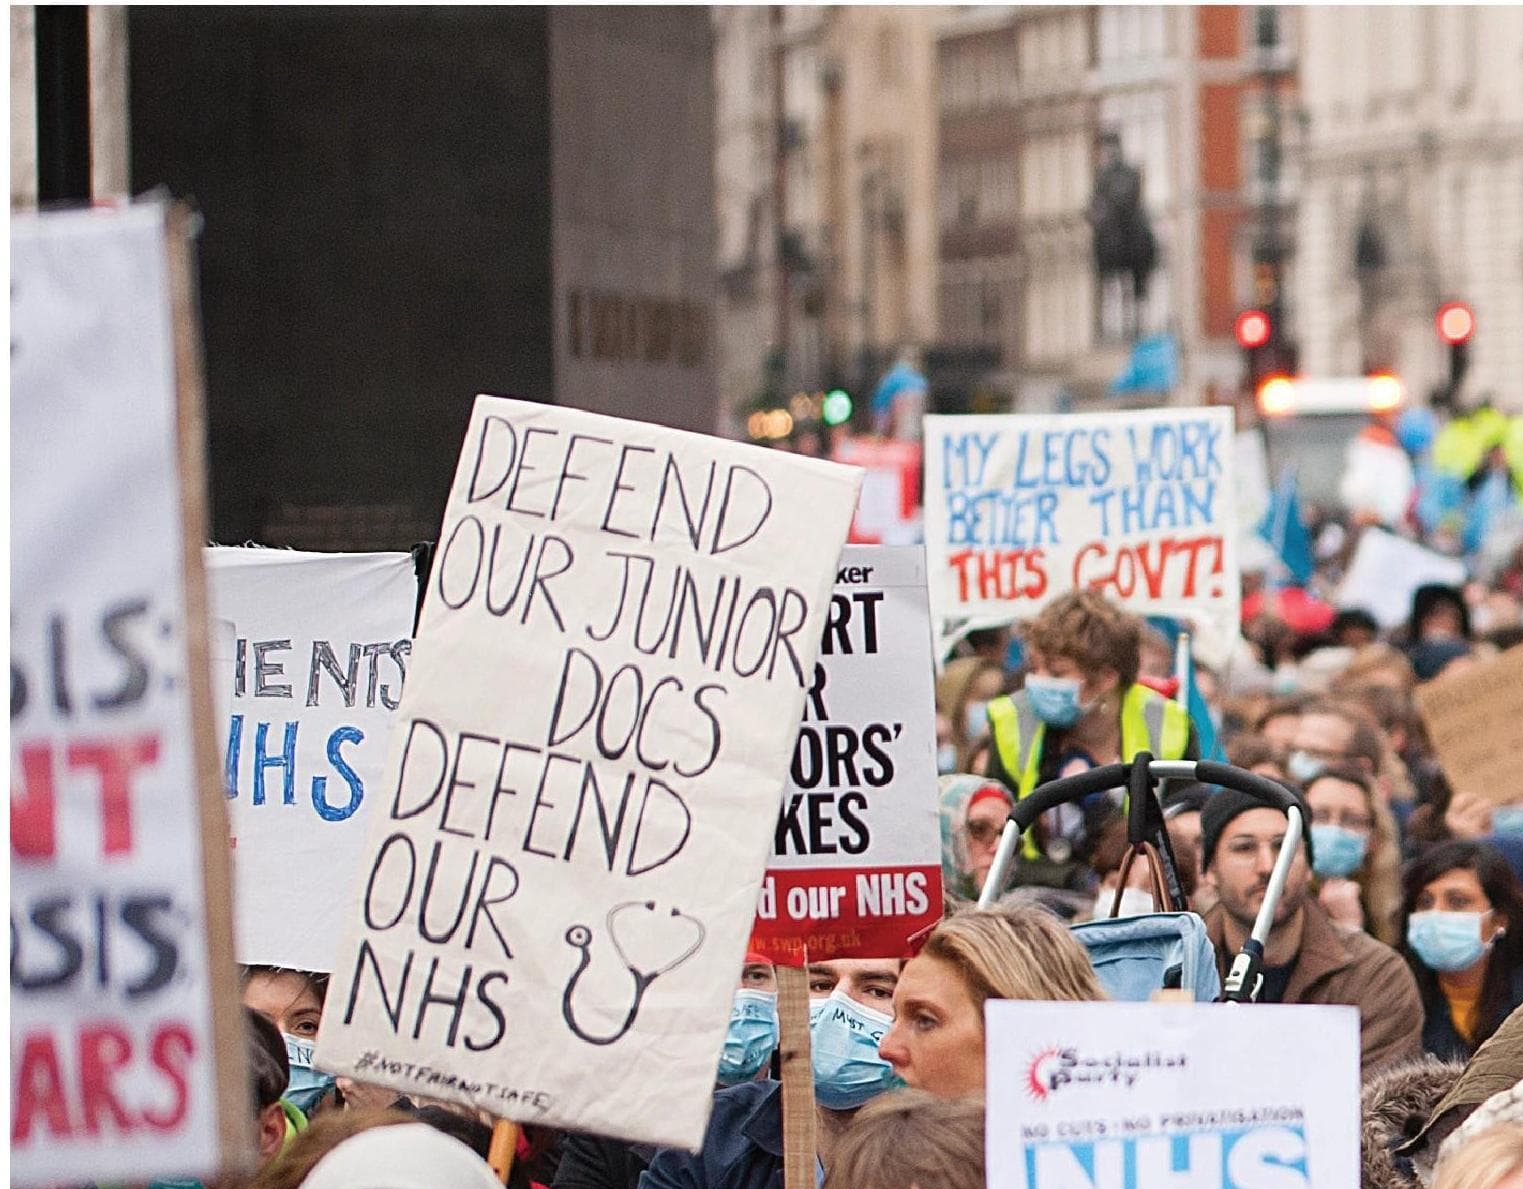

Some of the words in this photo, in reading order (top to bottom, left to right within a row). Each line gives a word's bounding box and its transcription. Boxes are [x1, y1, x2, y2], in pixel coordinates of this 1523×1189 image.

[468, 415, 772, 553] DEFEND
[942, 433, 1002, 489] MY
[1014, 428, 1111, 488] LEGS
[1129, 419, 1223, 481] WORK
[949, 492, 1061, 548] BETTER
[1091, 483, 1217, 536] THAN
[949, 545, 1047, 604] THIS
[1073, 536, 1225, 600] GOVT!
[439, 515, 575, 633] OUR
[585, 549, 811, 688] JUNIOR
[550, 647, 729, 777] DOCS
[391, 718, 693, 877] DEFEND
[364, 833, 521, 958] OUR
[787, 886, 846, 919] our
[856, 871, 928, 918] NHS
[345, 938, 509, 1051] NHS
